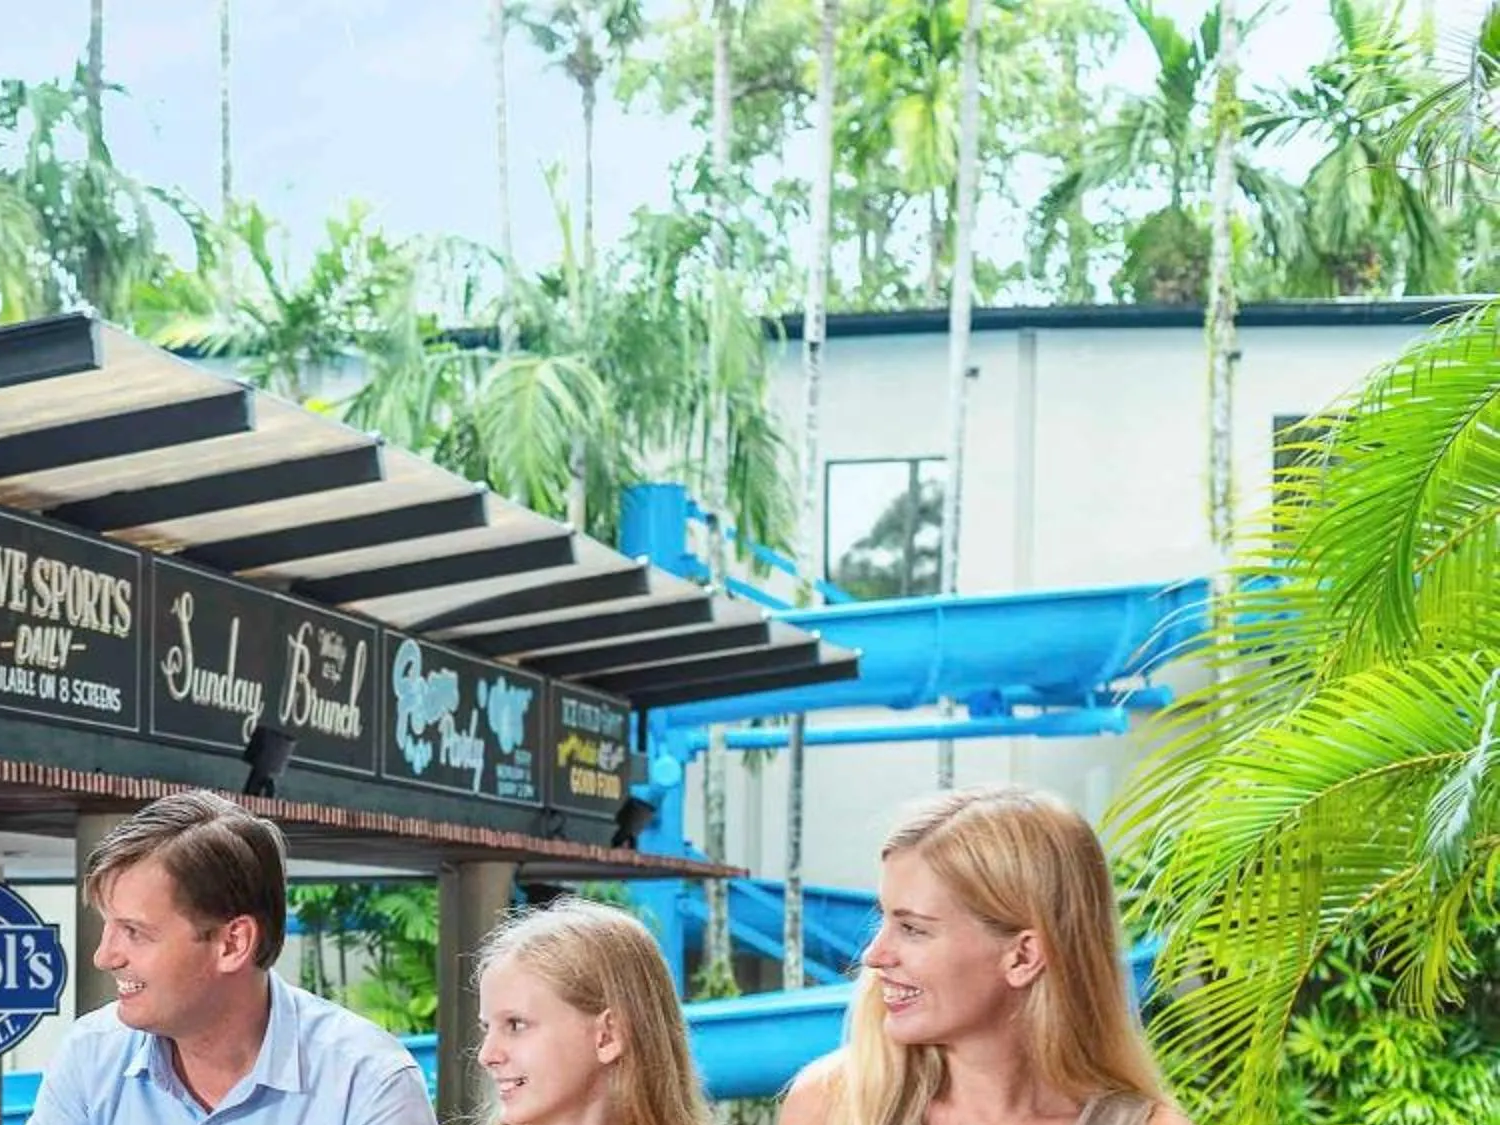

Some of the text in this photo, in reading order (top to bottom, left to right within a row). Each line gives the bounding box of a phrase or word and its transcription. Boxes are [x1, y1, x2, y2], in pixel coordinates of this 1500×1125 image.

[31, 557, 132, 638] SPORTS
[14, 624, 73, 670] DAILY
[160, 591, 264, 743] Sunday
[279, 621, 367, 738] Brunch
[39, 673, 56, 699] ON
[59, 676, 70, 704] 8
[71, 679, 122, 713] SCREENS
